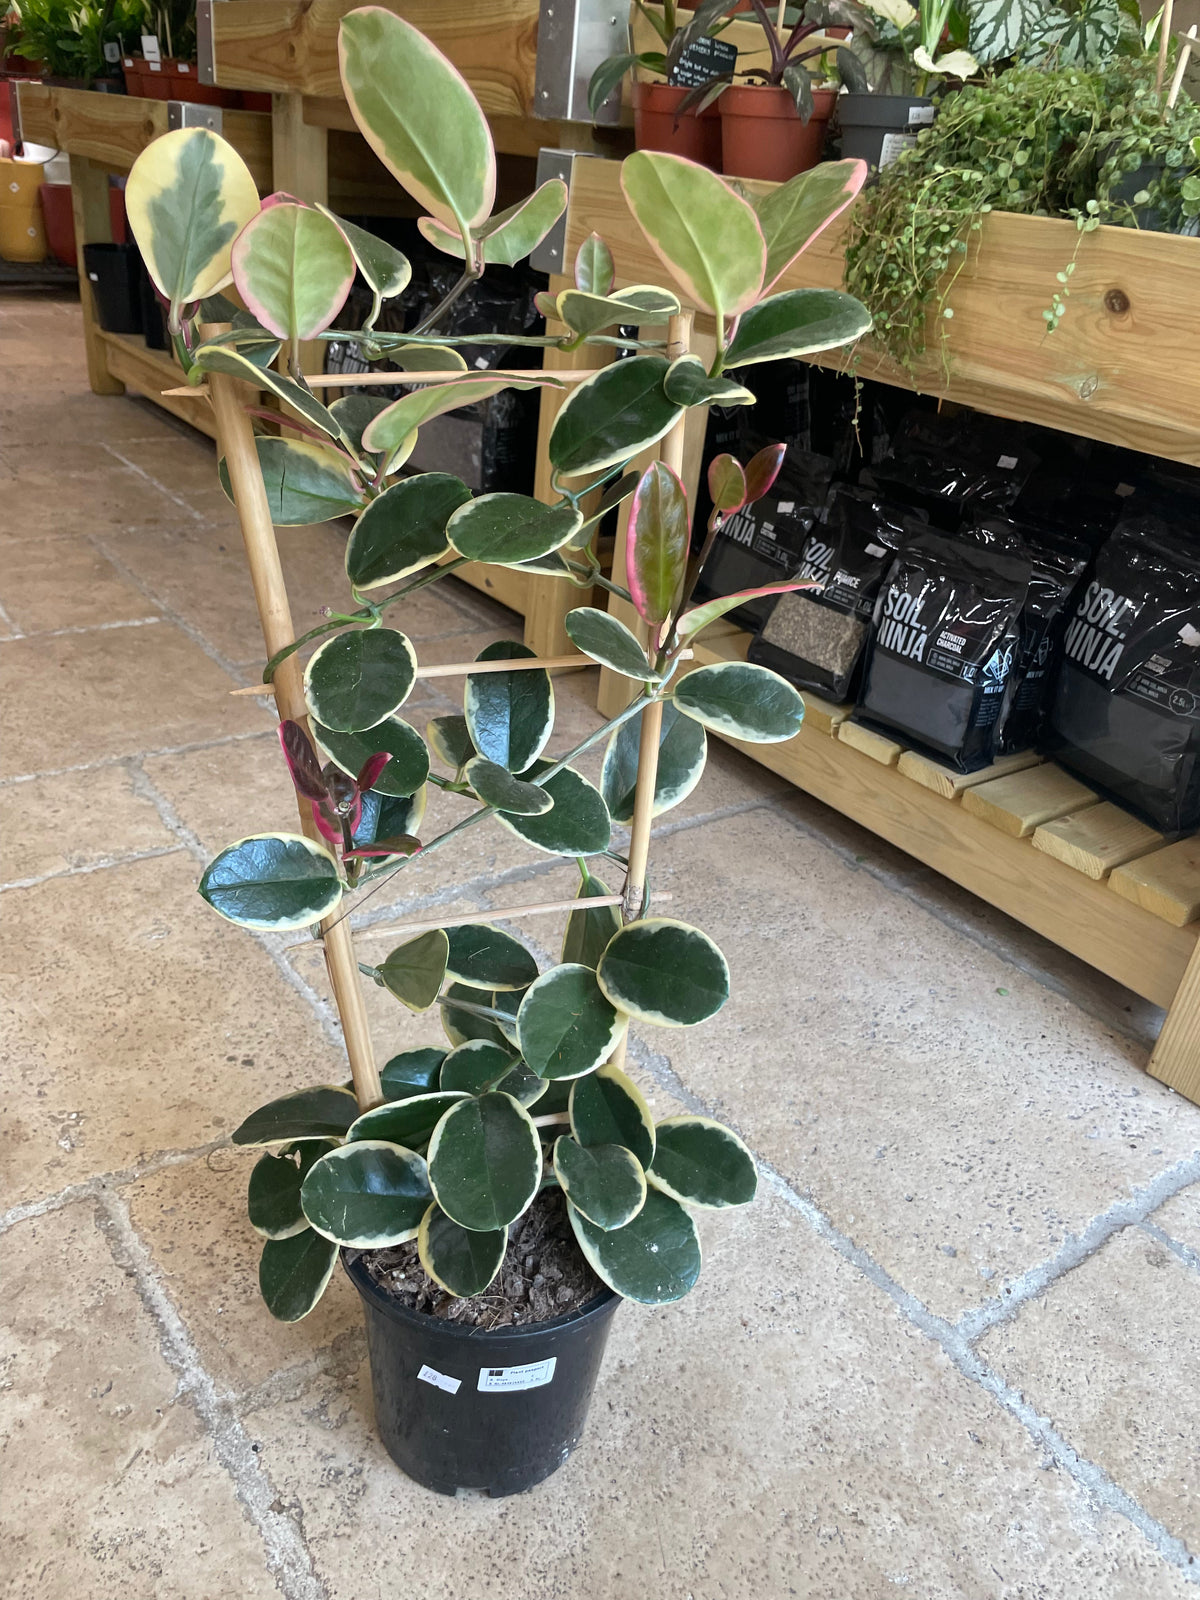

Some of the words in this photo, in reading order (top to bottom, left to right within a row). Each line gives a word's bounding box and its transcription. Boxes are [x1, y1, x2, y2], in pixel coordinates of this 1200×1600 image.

[833, 570, 861, 589] PUMICE
[884, 589, 928, 631] SOIL.
[1076, 580, 1127, 641] SOIL.
[876, 616, 929, 663] NINJA
[936, 637, 964, 655] CHARCOAL
[939, 630, 967, 646] ACTIVATED
[1063, 616, 1126, 681] NINJA
